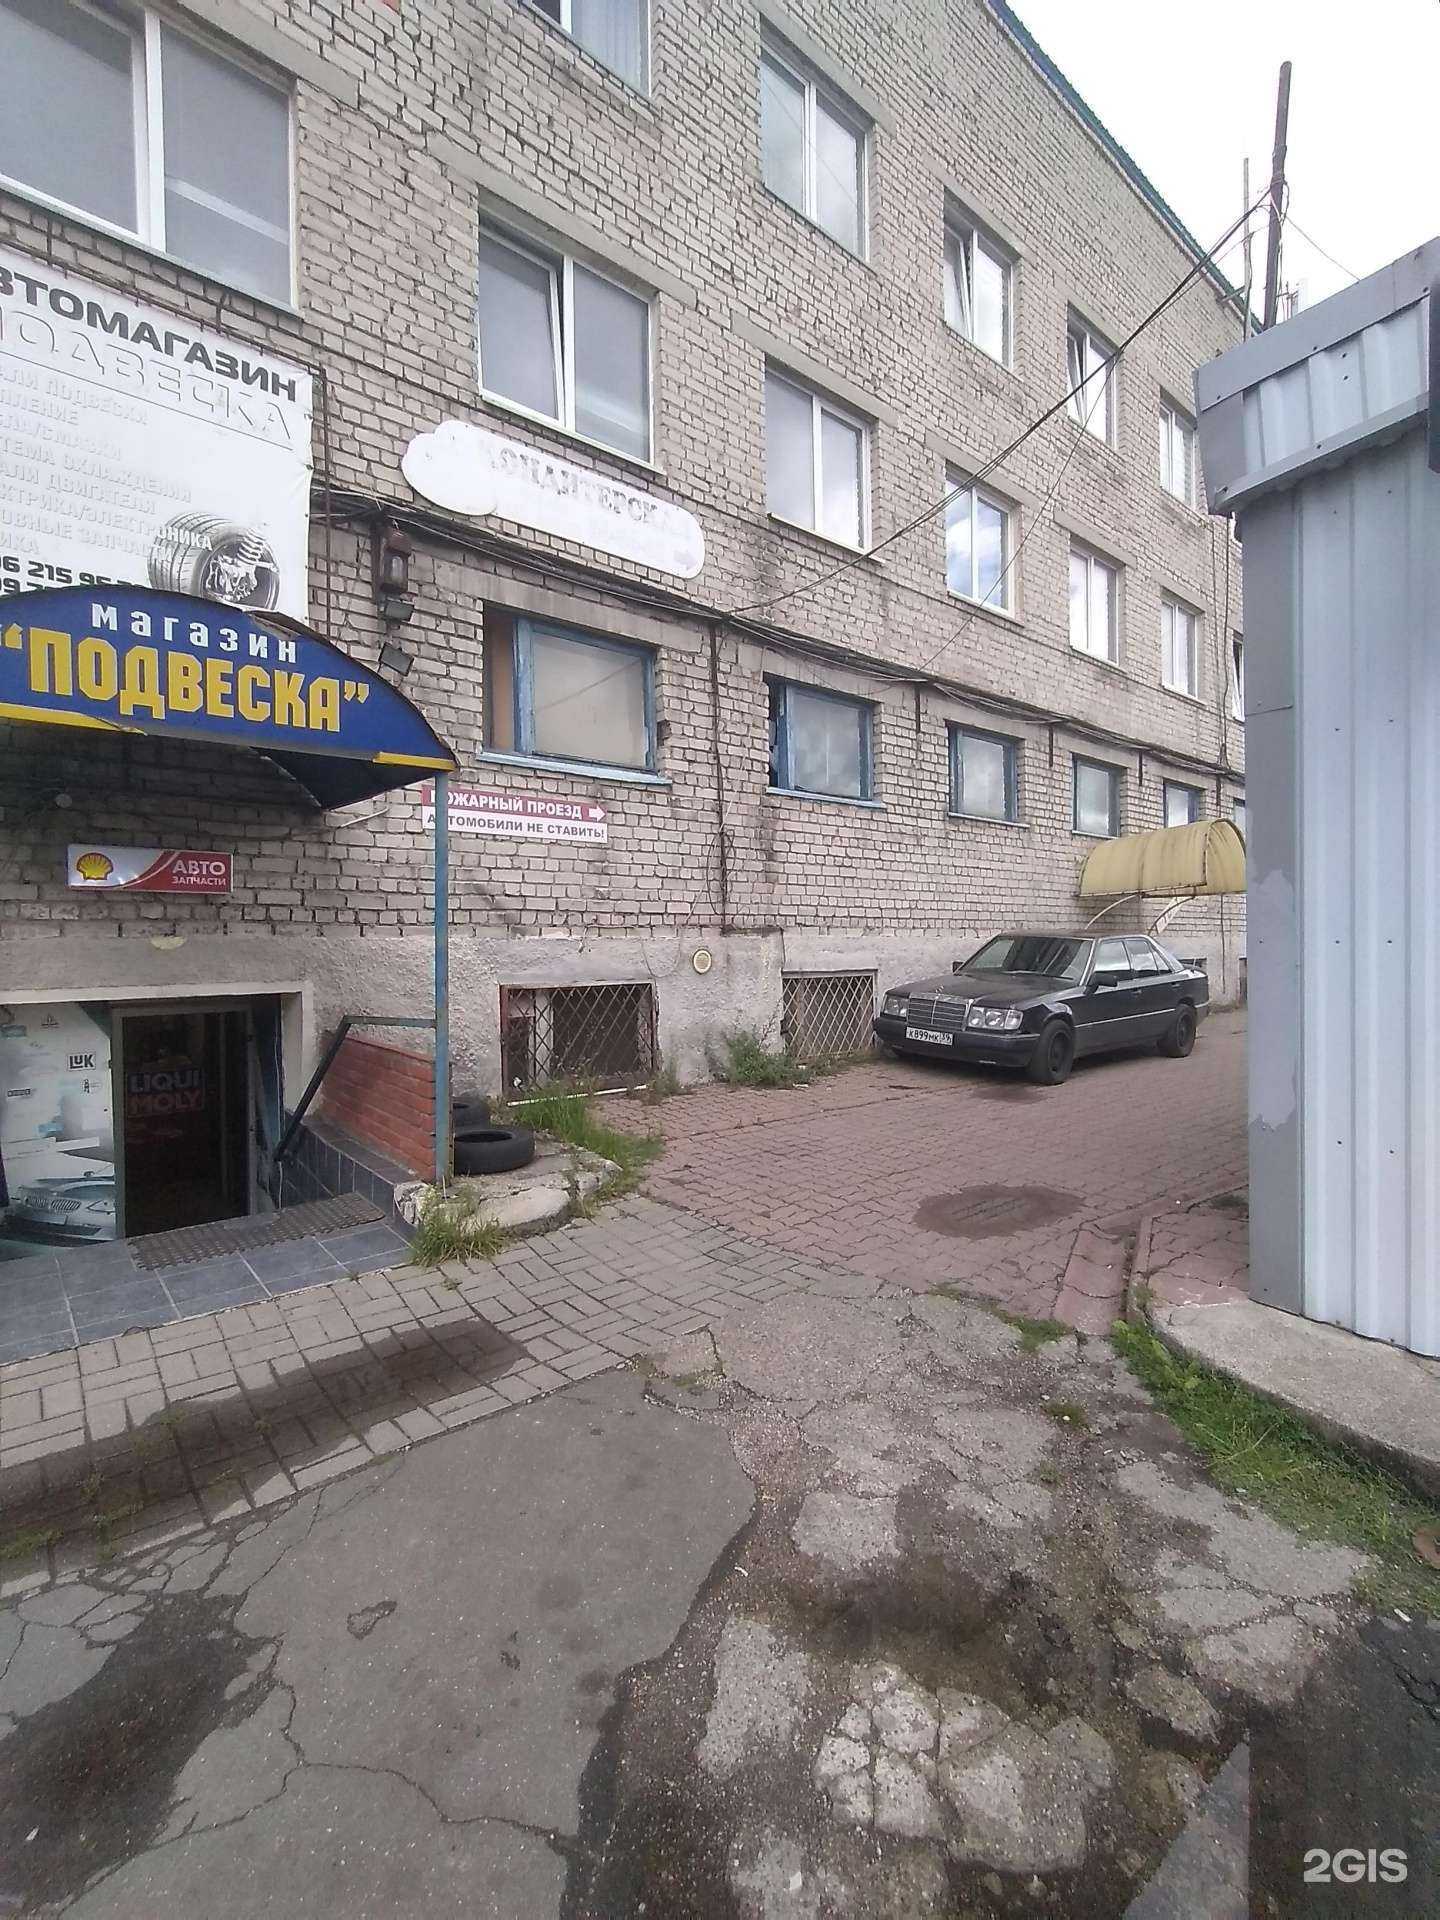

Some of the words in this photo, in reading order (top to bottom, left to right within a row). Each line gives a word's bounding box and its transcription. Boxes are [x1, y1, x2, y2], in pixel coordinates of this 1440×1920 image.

[0, 303, 292, 440] ОДВЕСКА
[0, 555, 20, 573] 6
[27, 560, 72, 584] 215
[527, 801, 582, 820] ПРОЕЗД
[427, 814, 523, 832] АТОМОБИЛИ
[527, 822, 544, 833] НЕ
[547, 824, 605, 839] СТАВИТЬ!
[173, 860, 226, 875] АВТО
[172, 876, 226, 886] ЗАПЧАСТИ
